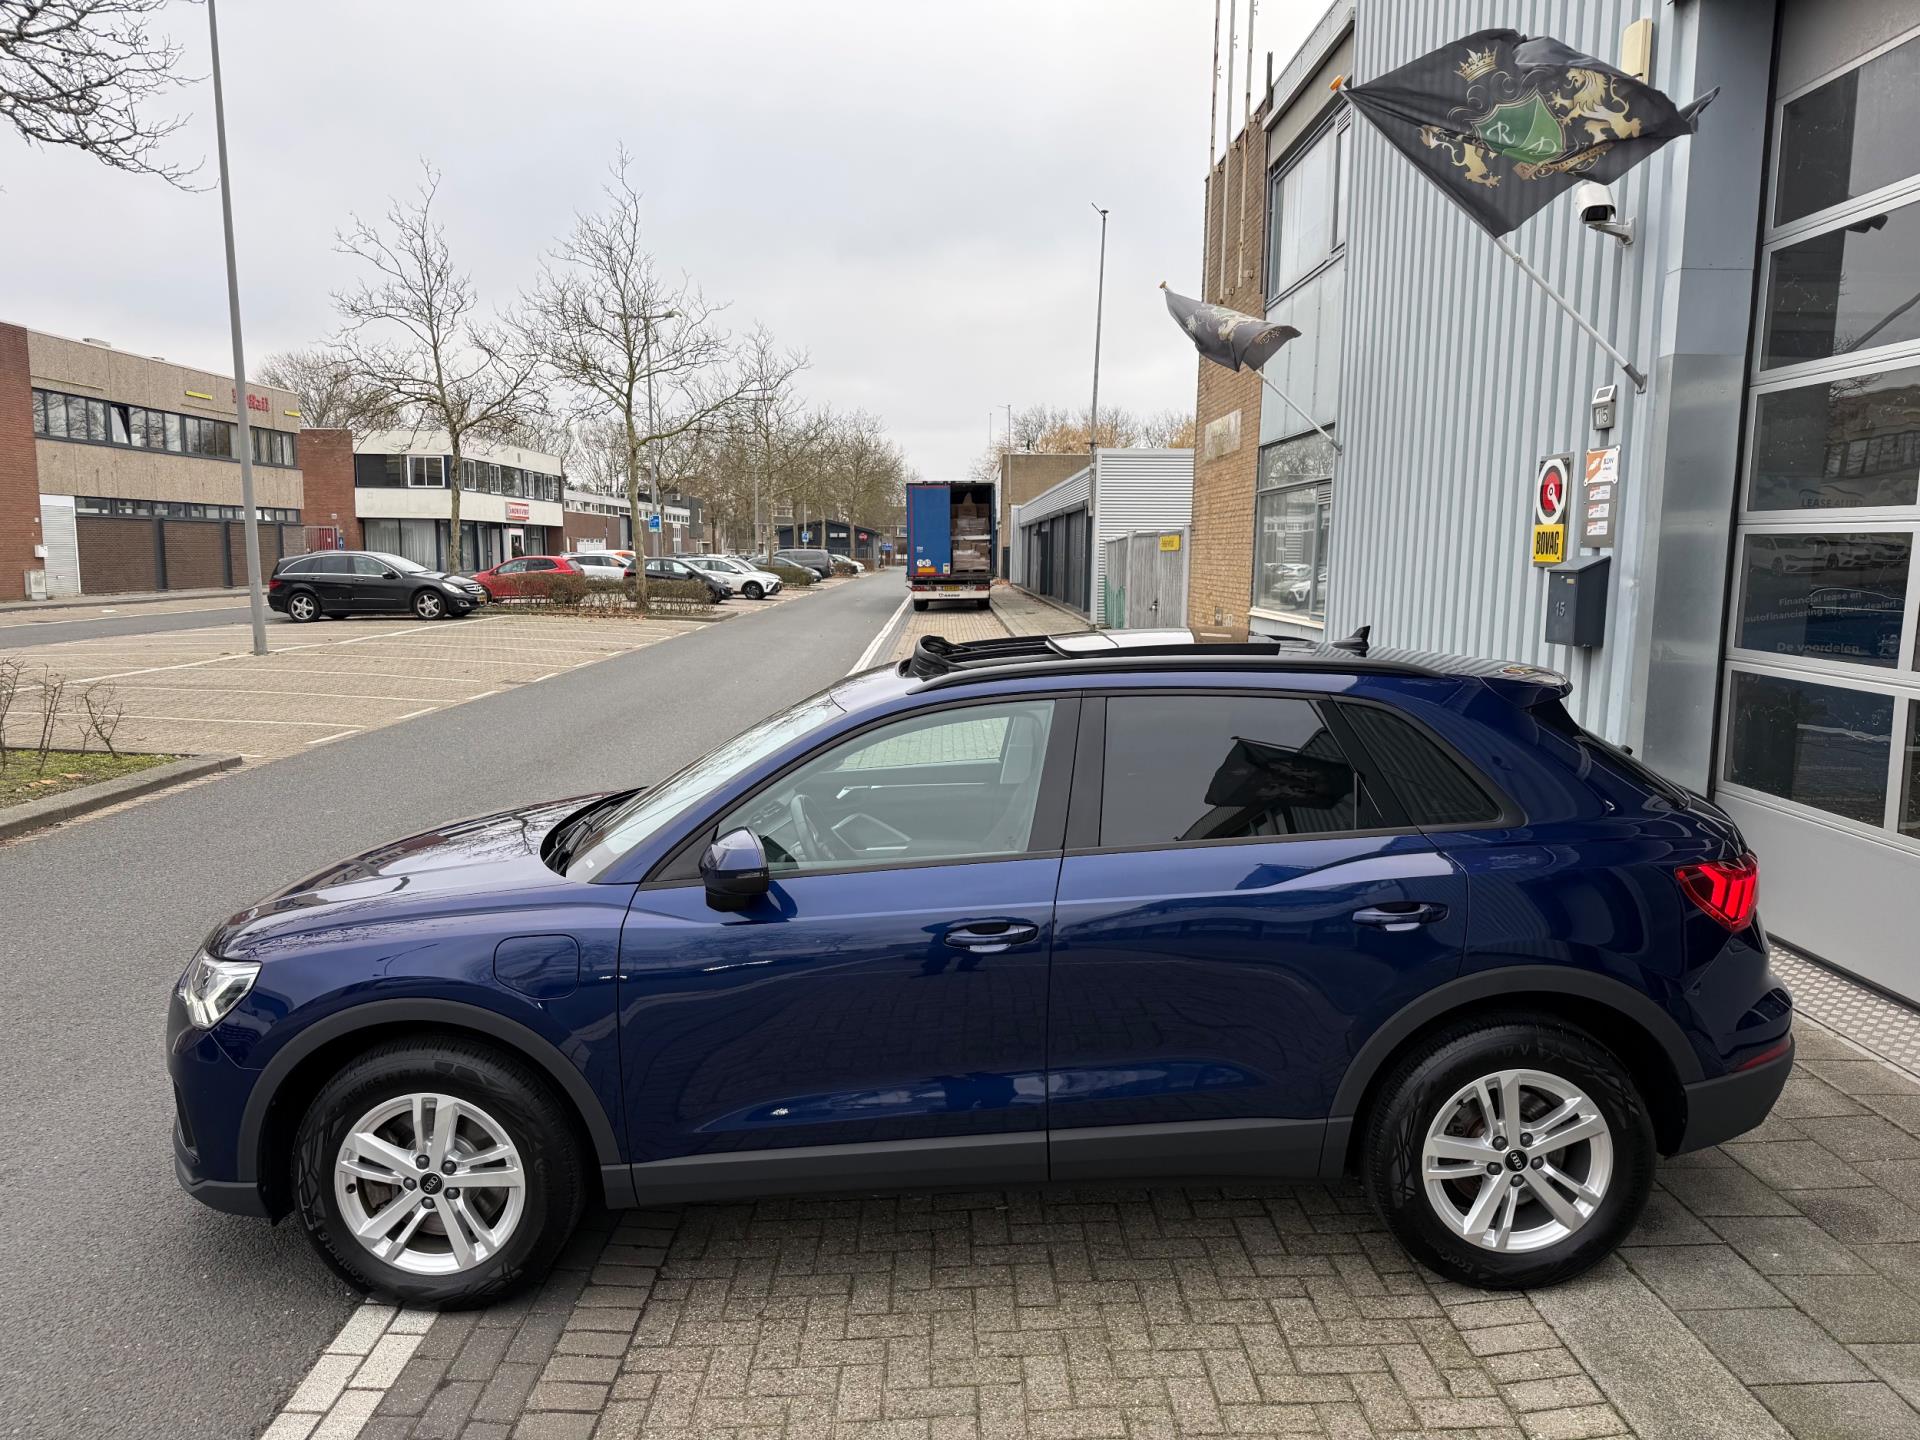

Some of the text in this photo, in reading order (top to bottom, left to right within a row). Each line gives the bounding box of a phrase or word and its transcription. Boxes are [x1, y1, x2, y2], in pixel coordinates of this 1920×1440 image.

[1486, 121, 1516, 144] R
[1595, 407, 1609, 425] 15
[1535, 531, 1560, 555] BOVAG
[1779, 594, 1822, 607] Financial
[1823, 592, 1847, 603] lease
[1555, 601, 1566, 617] 15
[1777, 641, 1860, 655] De voordelen
